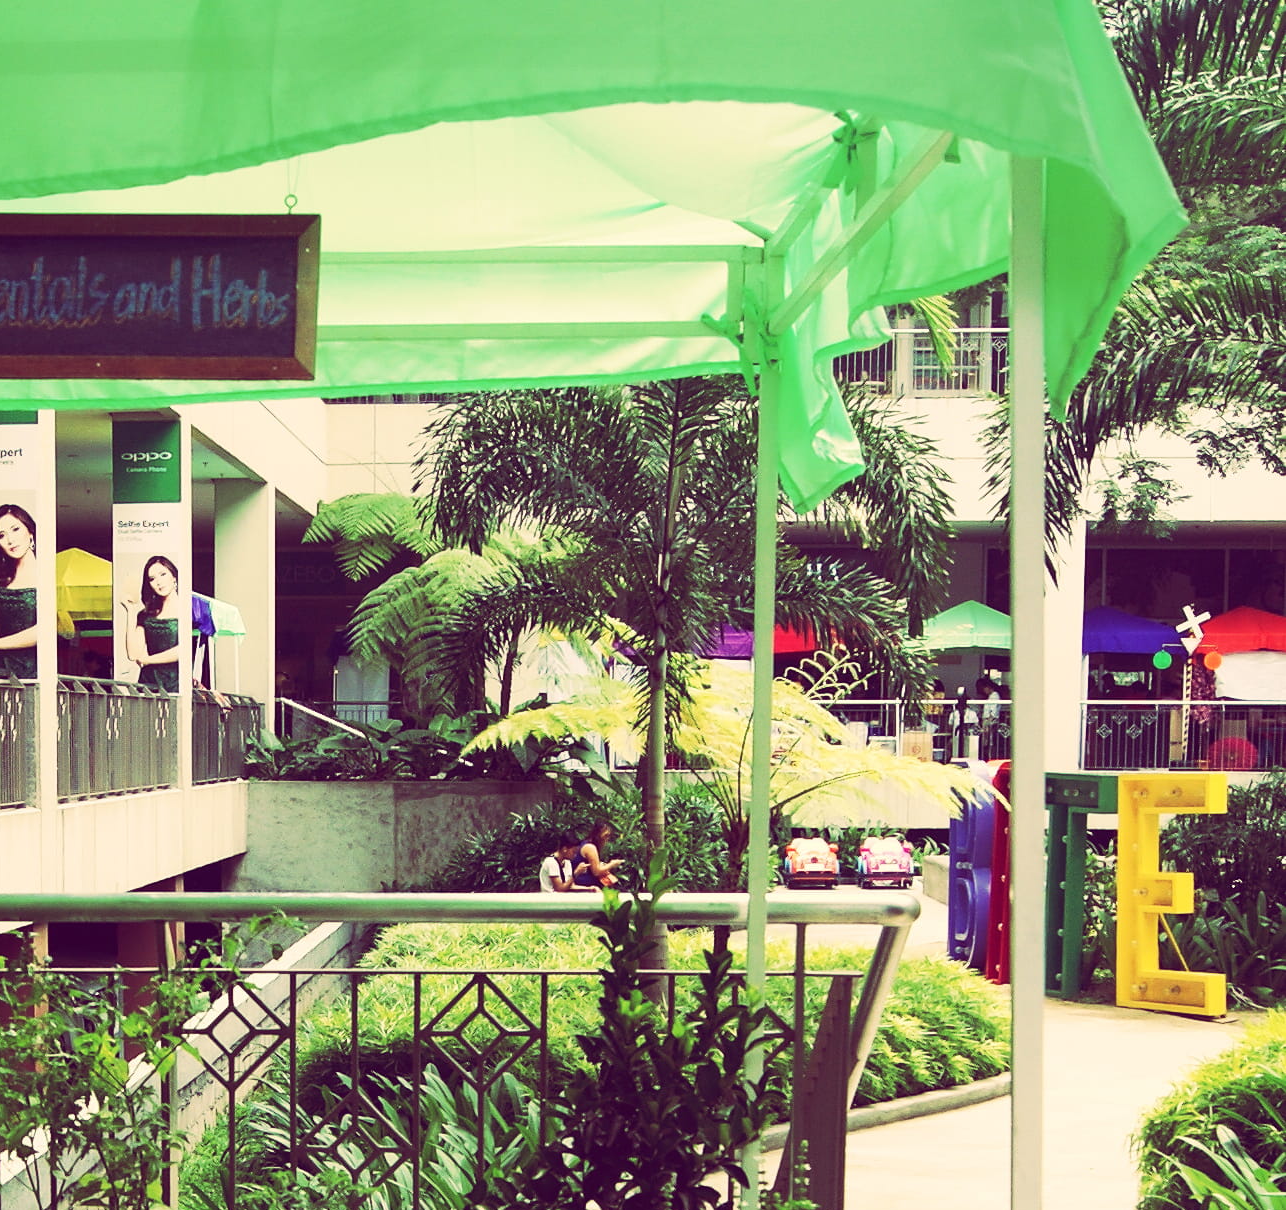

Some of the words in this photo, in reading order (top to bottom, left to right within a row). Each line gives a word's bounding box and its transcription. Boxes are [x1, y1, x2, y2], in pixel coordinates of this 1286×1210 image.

[112, 256, 183, 322] and
[191, 253, 289, 330] Herbs
[121, 451, 173, 462] oppo
